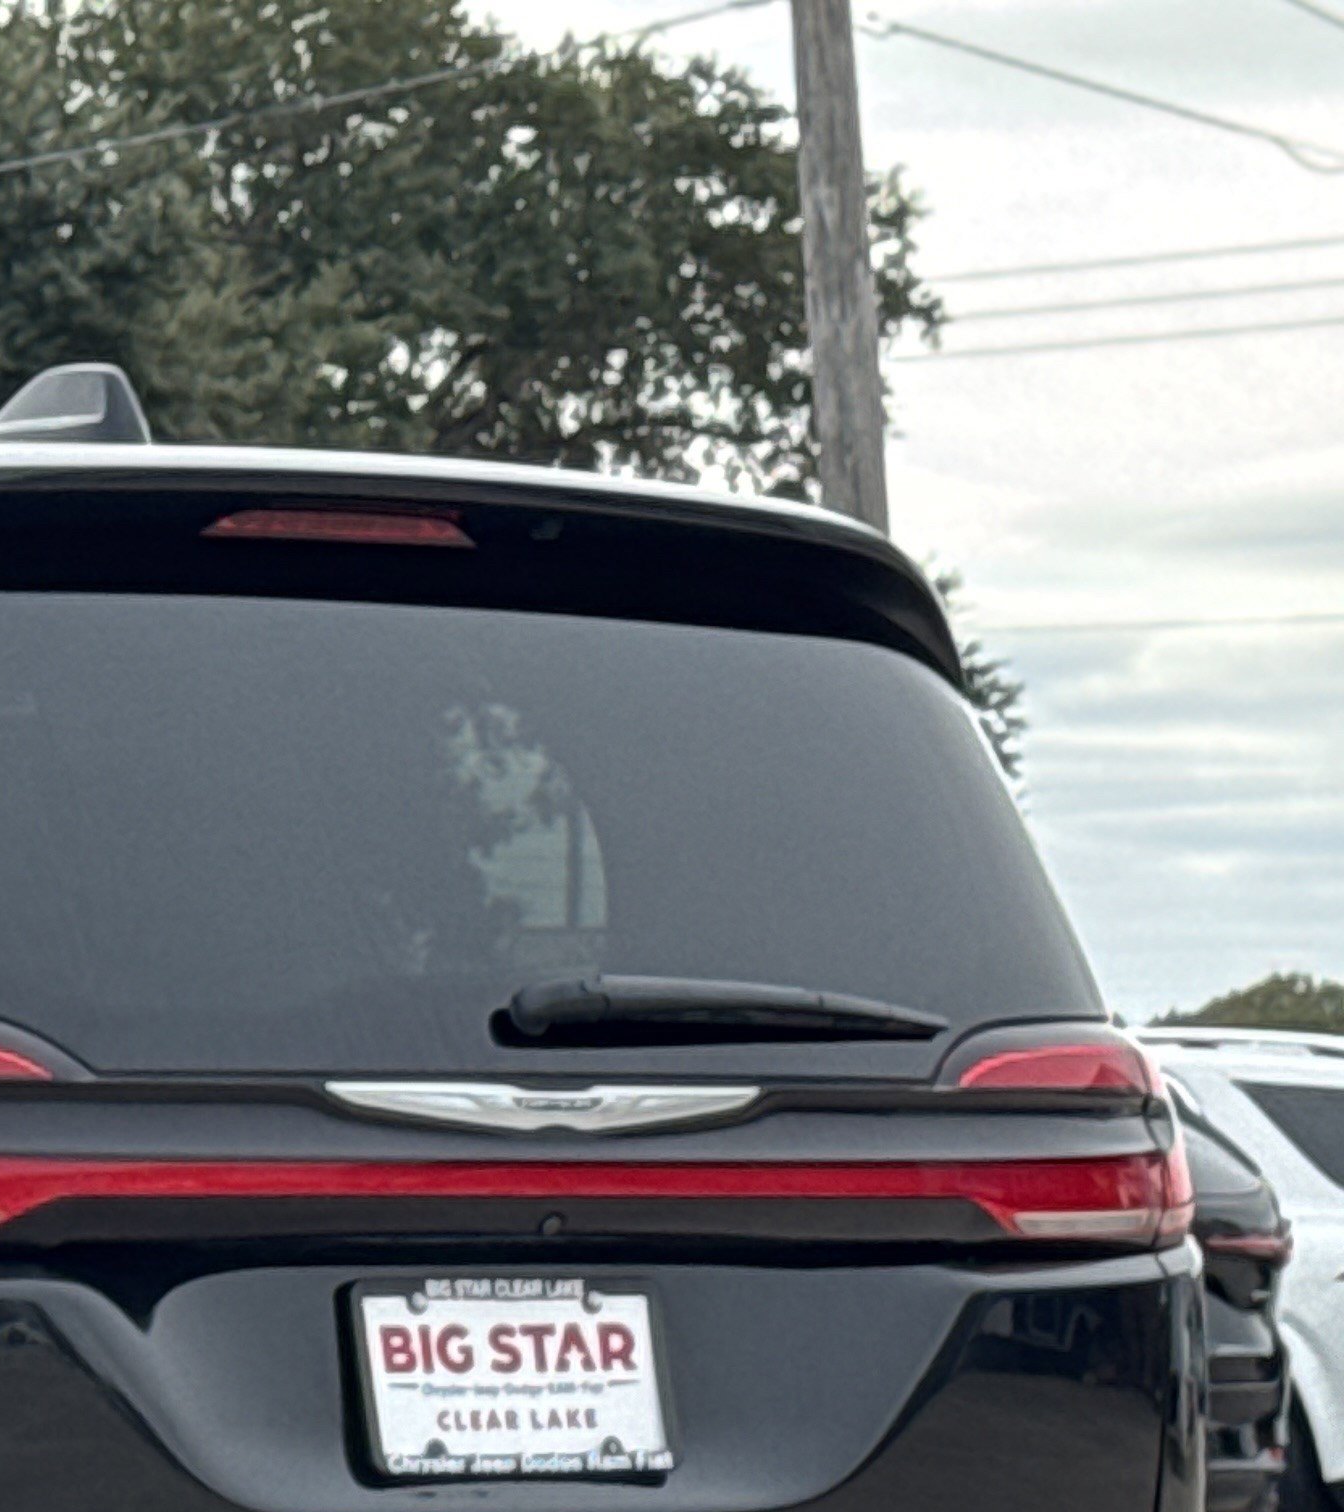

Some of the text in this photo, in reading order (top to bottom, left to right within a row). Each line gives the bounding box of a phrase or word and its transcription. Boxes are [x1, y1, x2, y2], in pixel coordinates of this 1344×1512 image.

[379, 1321, 639, 1374] BIG STAR
[436, 1407, 599, 1432] CLEAR LAKE
